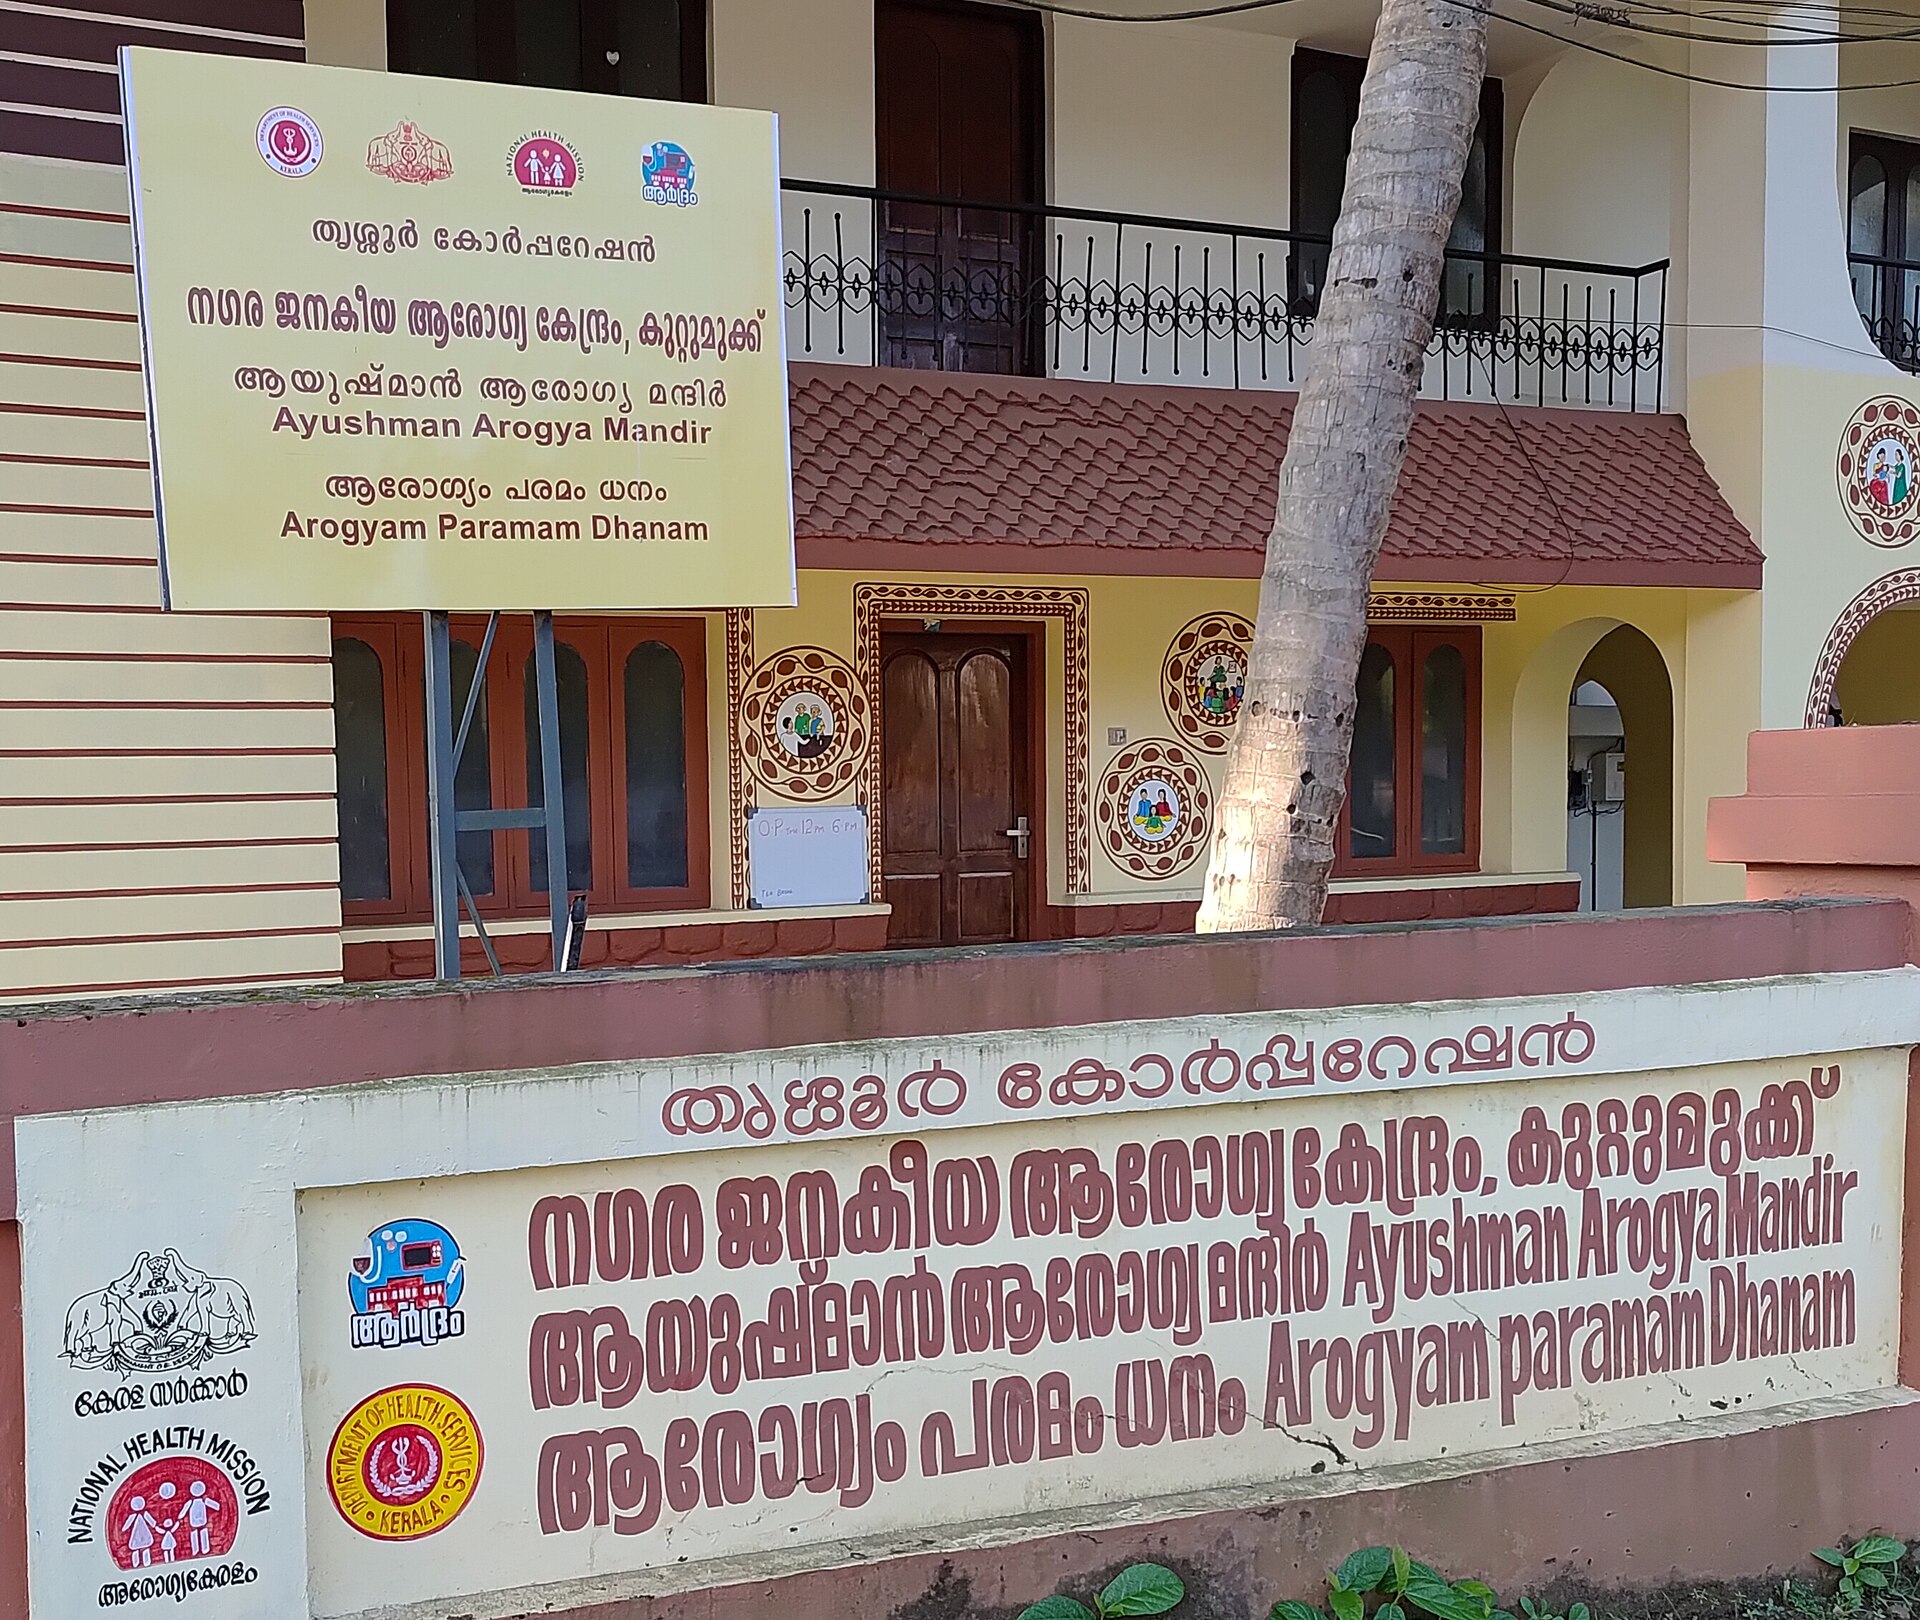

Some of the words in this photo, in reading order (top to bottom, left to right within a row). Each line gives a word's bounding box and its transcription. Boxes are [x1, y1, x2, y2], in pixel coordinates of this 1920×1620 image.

[506, 134, 529, 176] NATIONAL
[531, 130, 565, 143] HEALTH
[566, 142, 585, 182] MISSION
[433, 226, 656, 263] കോർപ്പറേഷൻ
[187, 286, 264, 327] നഗര
[274, 285, 396, 334] ജനകീയ
[408, 299, 527, 351] ആരോഗ്യ
[638, 308, 766, 363] കുറ്റുമുക്ക്
[234, 362, 462, 405] ആയുഷ്മാൻ
[480, 377, 633, 413] ആരോഗ്യ
[649, 379, 727, 408] മന്ദിർ
[272, 406, 461, 440] Ayushman
[472, 413, 592, 447] Arogya
[604, 416, 712, 444] Mandir
[325, 475, 492, 507] ആരോഗ്യം
[505, 478, 586, 500] പരമം
[599, 479, 668, 501] ധനം
[281, 511, 427, 546] Arogyam
[438, 514, 581, 539] Paramam
[592, 515, 709, 541] Dhanam
[998, 1011, 1596, 1109] കോർപ്പറേഷൻ
[529, 1184, 704, 1291] നഗര
[716, 1140, 1000, 1269] ജനകീയ
[1010, 1129, 1285, 1238] ആരോഗ്യ
[951, 1243, 1203, 1355] ആരോഗ്യ
[1342, 1197, 1569, 1324] Ayushman
[1577, 1187, 1721, 1290] Arogya
[1724, 1153, 1858, 1258] Mandir
[75, 1384, 147, 1418] കേരള
[150, 1367, 248, 1408] സർക്കാർ
[537, 1393, 907, 1536] ആരോഗ്യം
[920, 1371, 1106, 1477] പരമം
[1115, 1353, 1246, 1448] ധനം
[1263, 1320, 1490, 1449] Arogyam
[1499, 1288, 1705, 1426] paramam
[1709, 1261, 1856, 1366] Dhanam
[335, 1418, 371, 1516] DEPARTMENT
[365, 1402, 385, 1429] OF
[386, 1393, 446, 1425] HEALTH
[437, 1411, 473, 1493] SERVICES
[67, 1454, 127, 1545] NATIONAL
[124, 1426, 205, 1463] HEALTH
[205, 1433, 271, 1516] MISSION
[379, 1500, 445, 1534] KERALA
